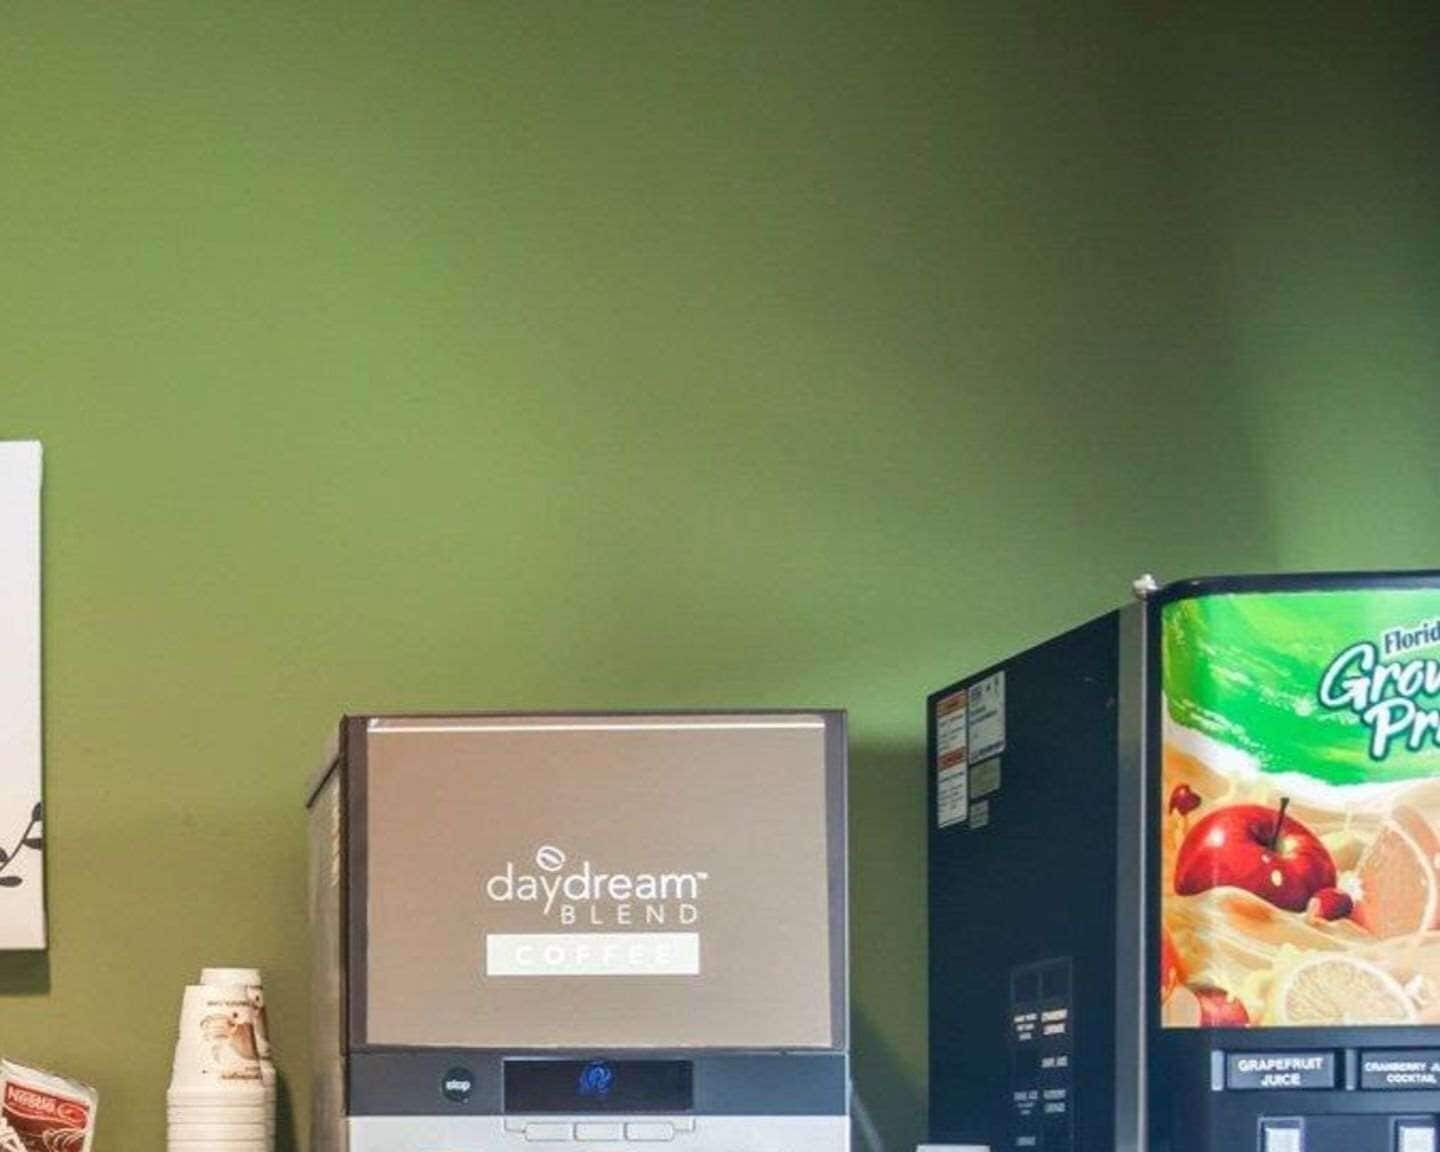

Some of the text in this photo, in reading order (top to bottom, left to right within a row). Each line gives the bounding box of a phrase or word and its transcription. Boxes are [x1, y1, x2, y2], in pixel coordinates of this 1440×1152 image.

[1362, 697, 1440, 759] Pr
[561, 903, 698, 925] BLEND
[515, 943, 672, 967] COFFEE
[1237, 1057, 1324, 1072] GRAPEFRUIT
[1261, 1072, 1302, 1087] JUICE
[1386, 1073, 1438, 1084] COCKTAIL
